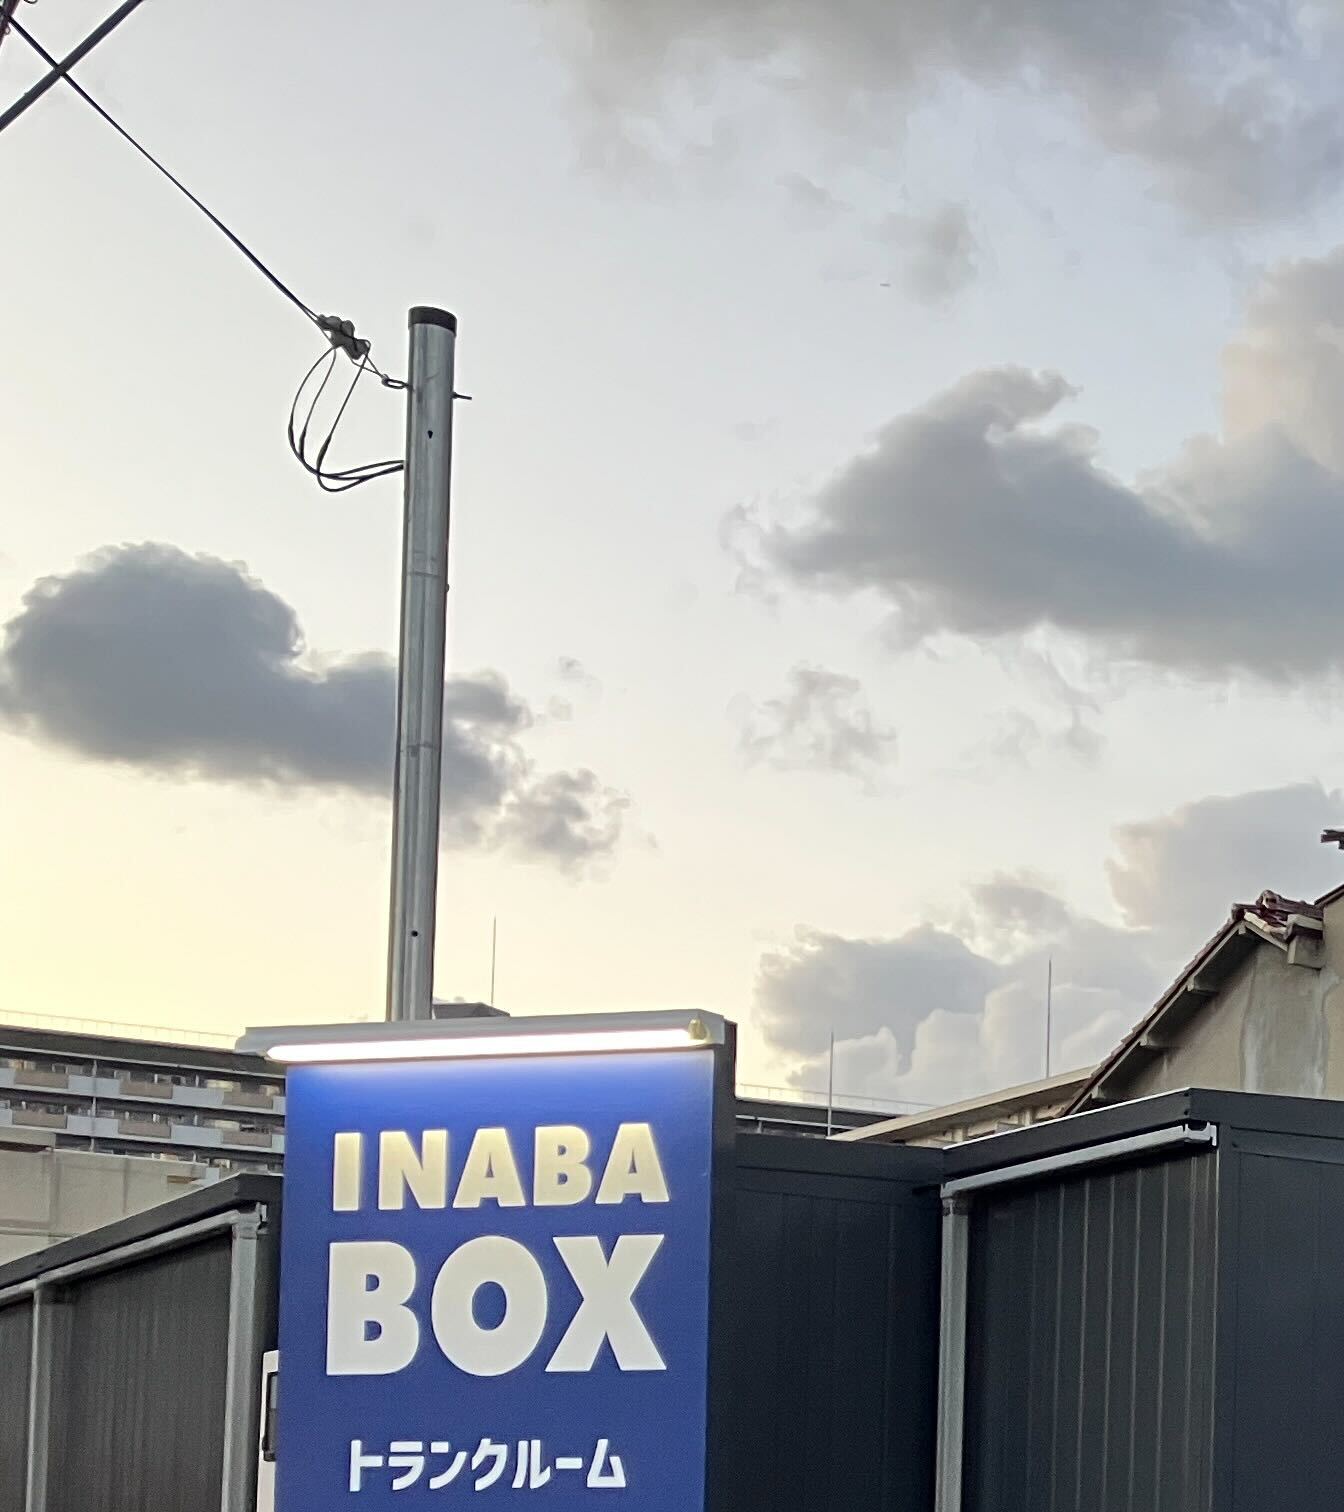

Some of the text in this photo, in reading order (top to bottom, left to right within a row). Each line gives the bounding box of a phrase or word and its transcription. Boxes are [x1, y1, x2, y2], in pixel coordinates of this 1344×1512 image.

[333, 1122, 670, 1211] INABA
[326, 1234, 667, 1377] BOX
[349, 1438, 627, 1492] トランクルーム
